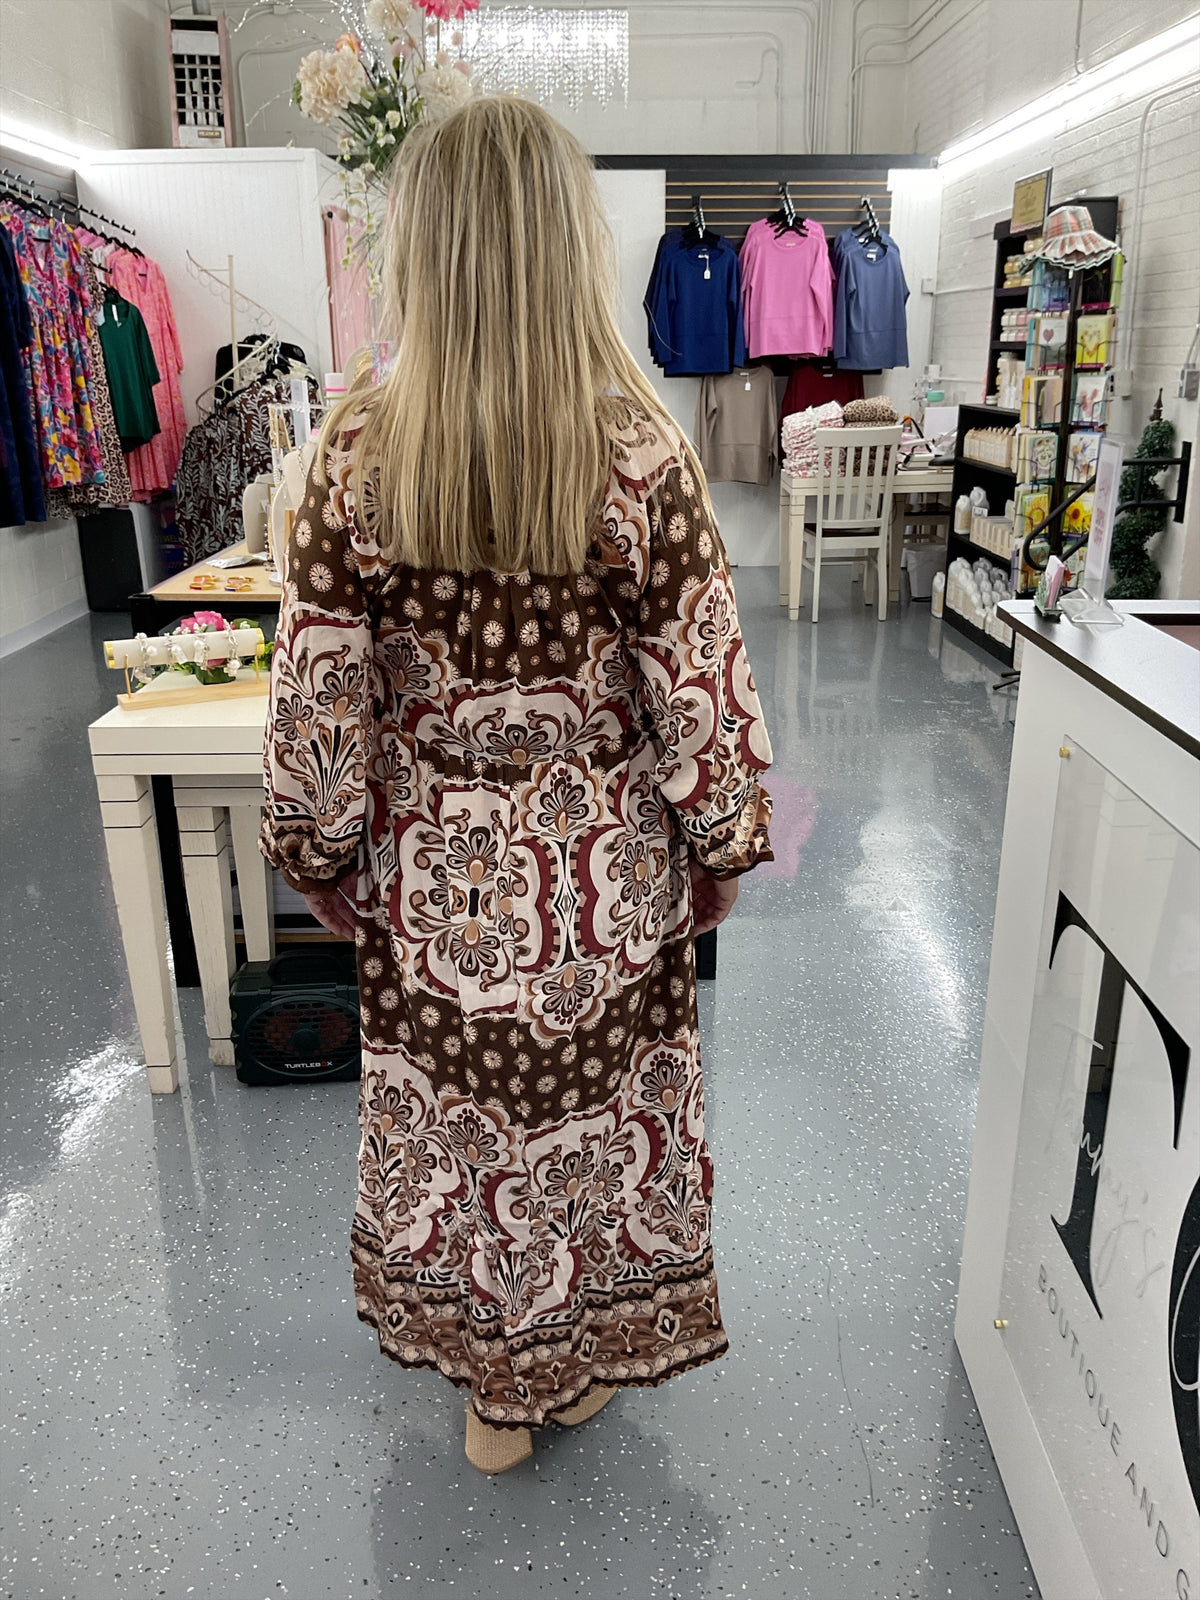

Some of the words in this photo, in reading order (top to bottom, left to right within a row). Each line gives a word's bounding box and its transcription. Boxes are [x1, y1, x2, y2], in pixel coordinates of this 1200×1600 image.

[285, 1061, 333, 1069] TURTLEBOX
[1038, 1263, 1122, 1458] BOUTIQUE
[1124, 1462, 1169, 1558] AND
